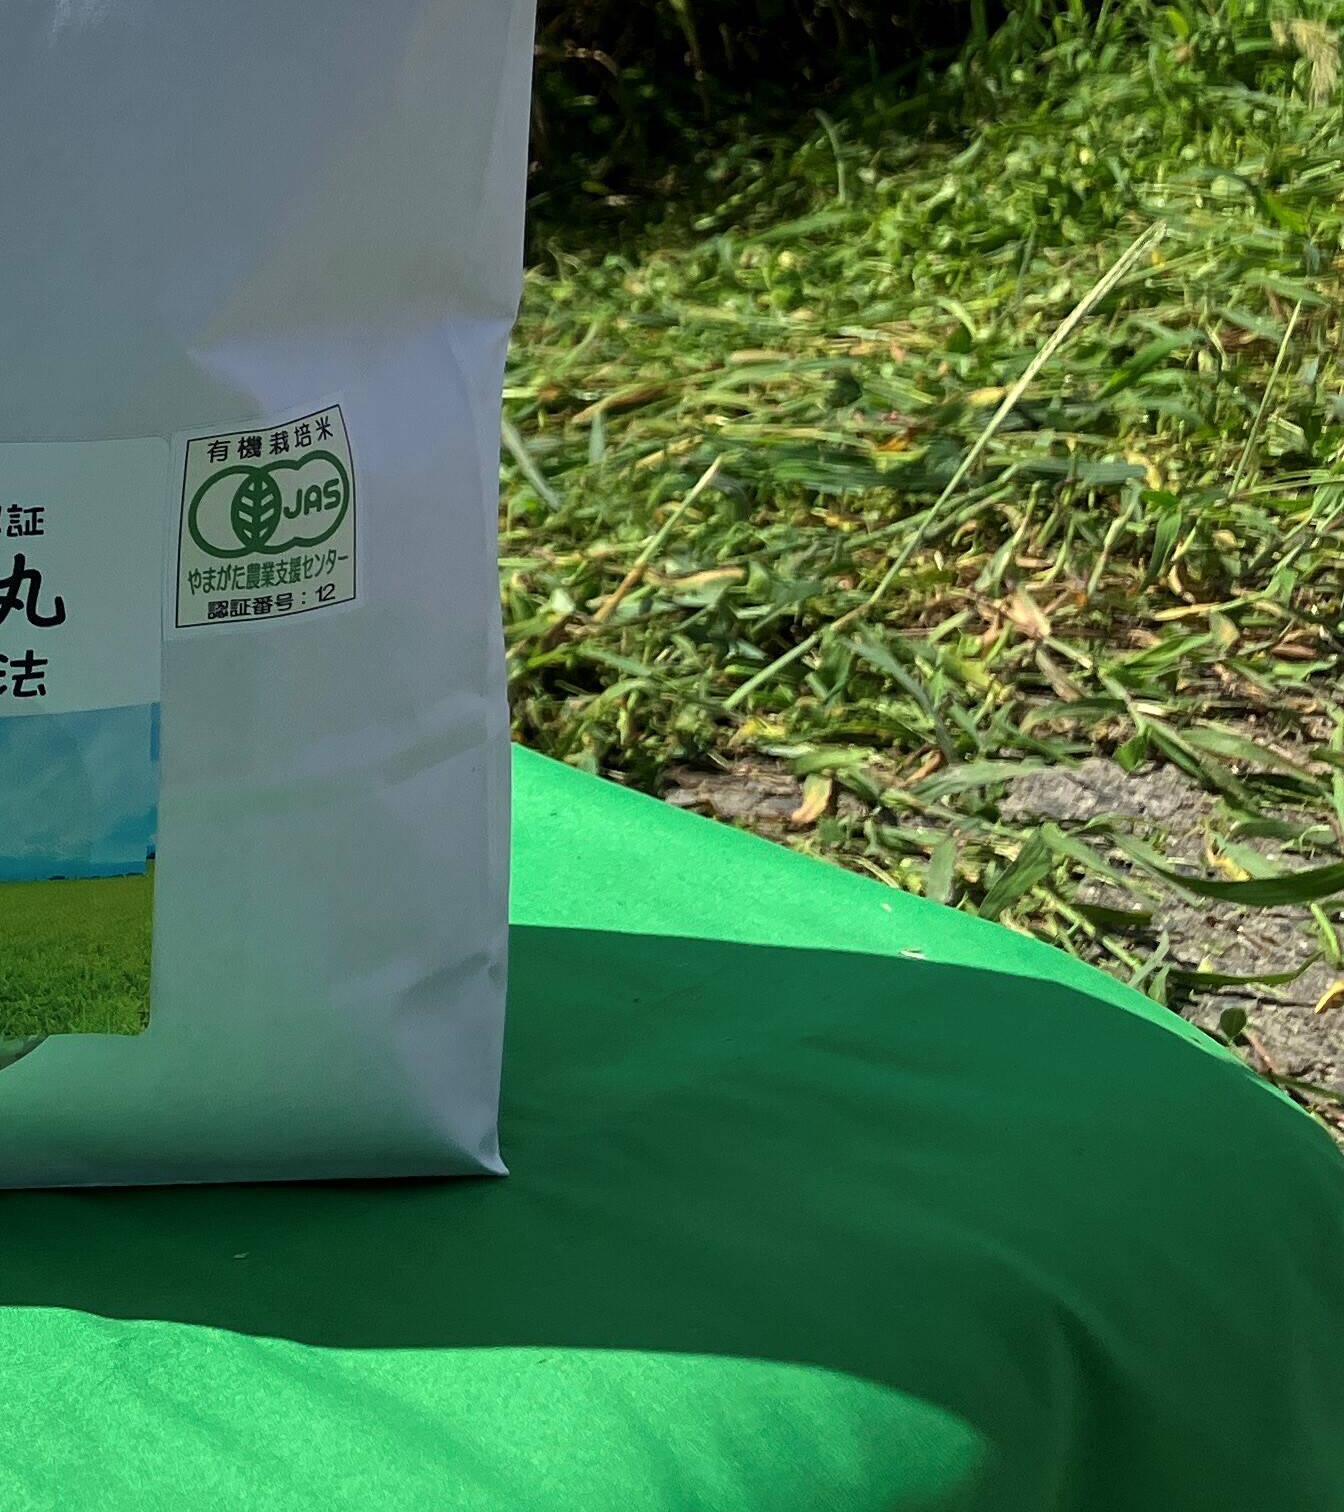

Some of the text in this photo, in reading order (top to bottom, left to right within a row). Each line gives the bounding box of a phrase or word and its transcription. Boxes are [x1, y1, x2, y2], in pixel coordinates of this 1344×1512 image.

[207, 415, 334, 464] 有機栽培米
[283, 478, 341, 519] JAS
[187, 548, 349, 596] やまがた農業支援センター
